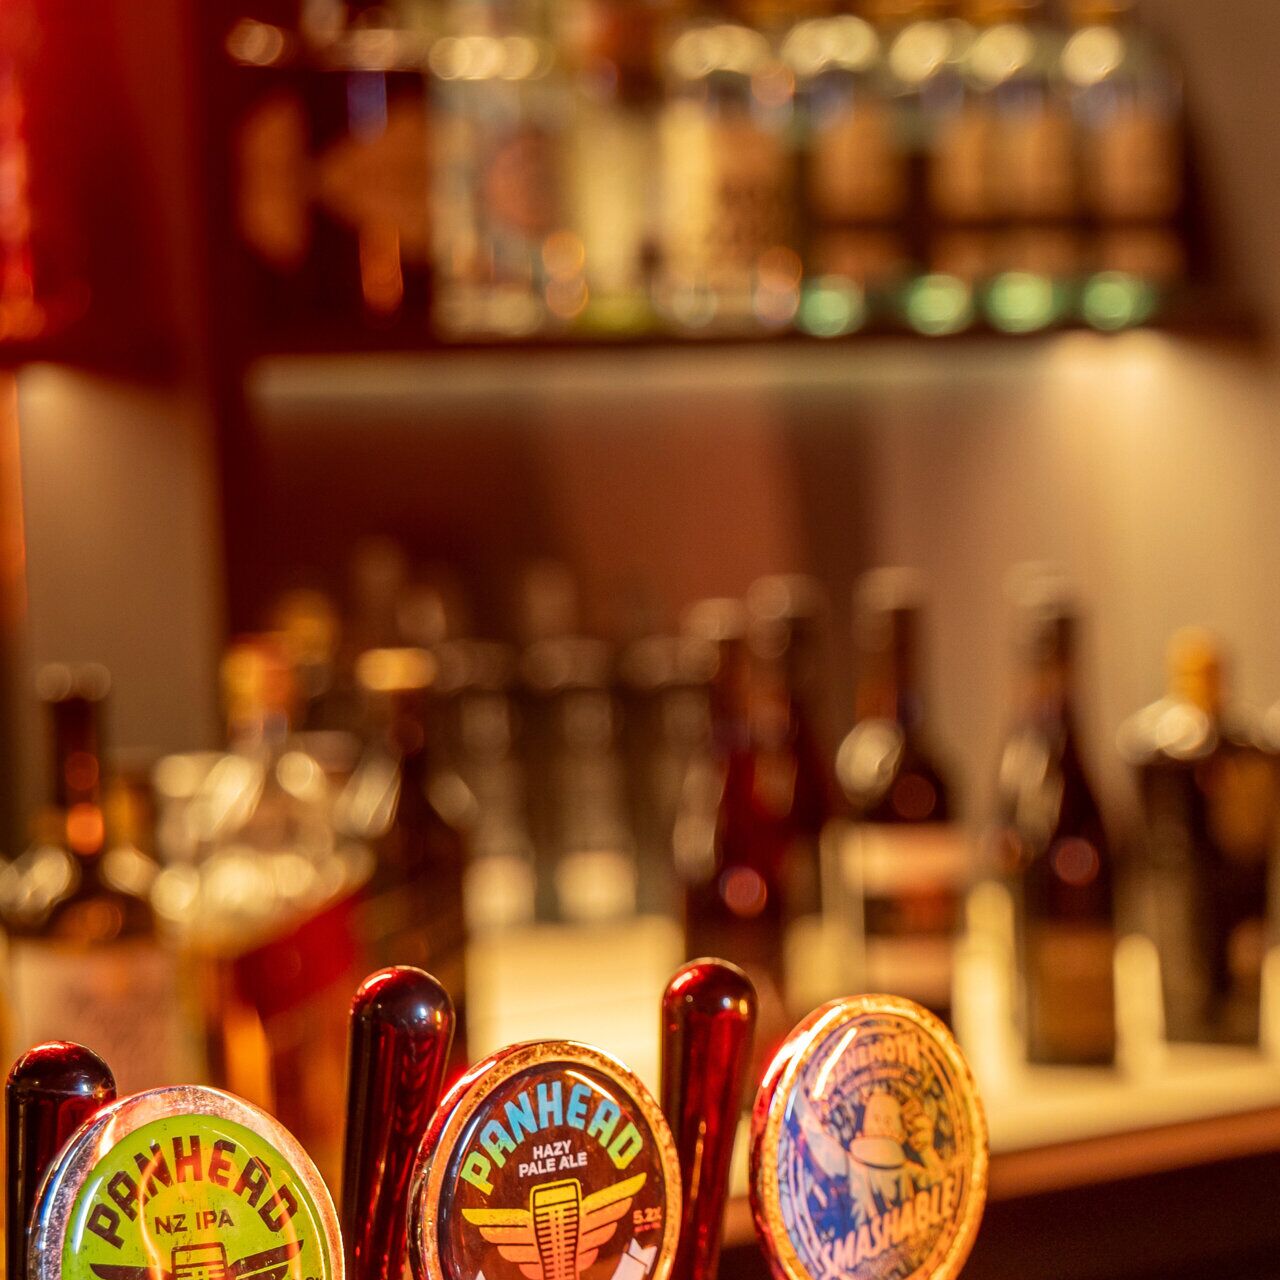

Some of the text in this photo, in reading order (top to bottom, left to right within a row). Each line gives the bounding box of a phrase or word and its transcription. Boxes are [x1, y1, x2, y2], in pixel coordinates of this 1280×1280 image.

[460, 1081, 643, 1196] PANHEAD
[533, 1140, 572, 1160] HAZY
[518, 1152, 588, 1178] PALE ALE
[86, 1135, 298, 1250] PANHEAD
[154, 1209, 235, 1235] NZ IPA
